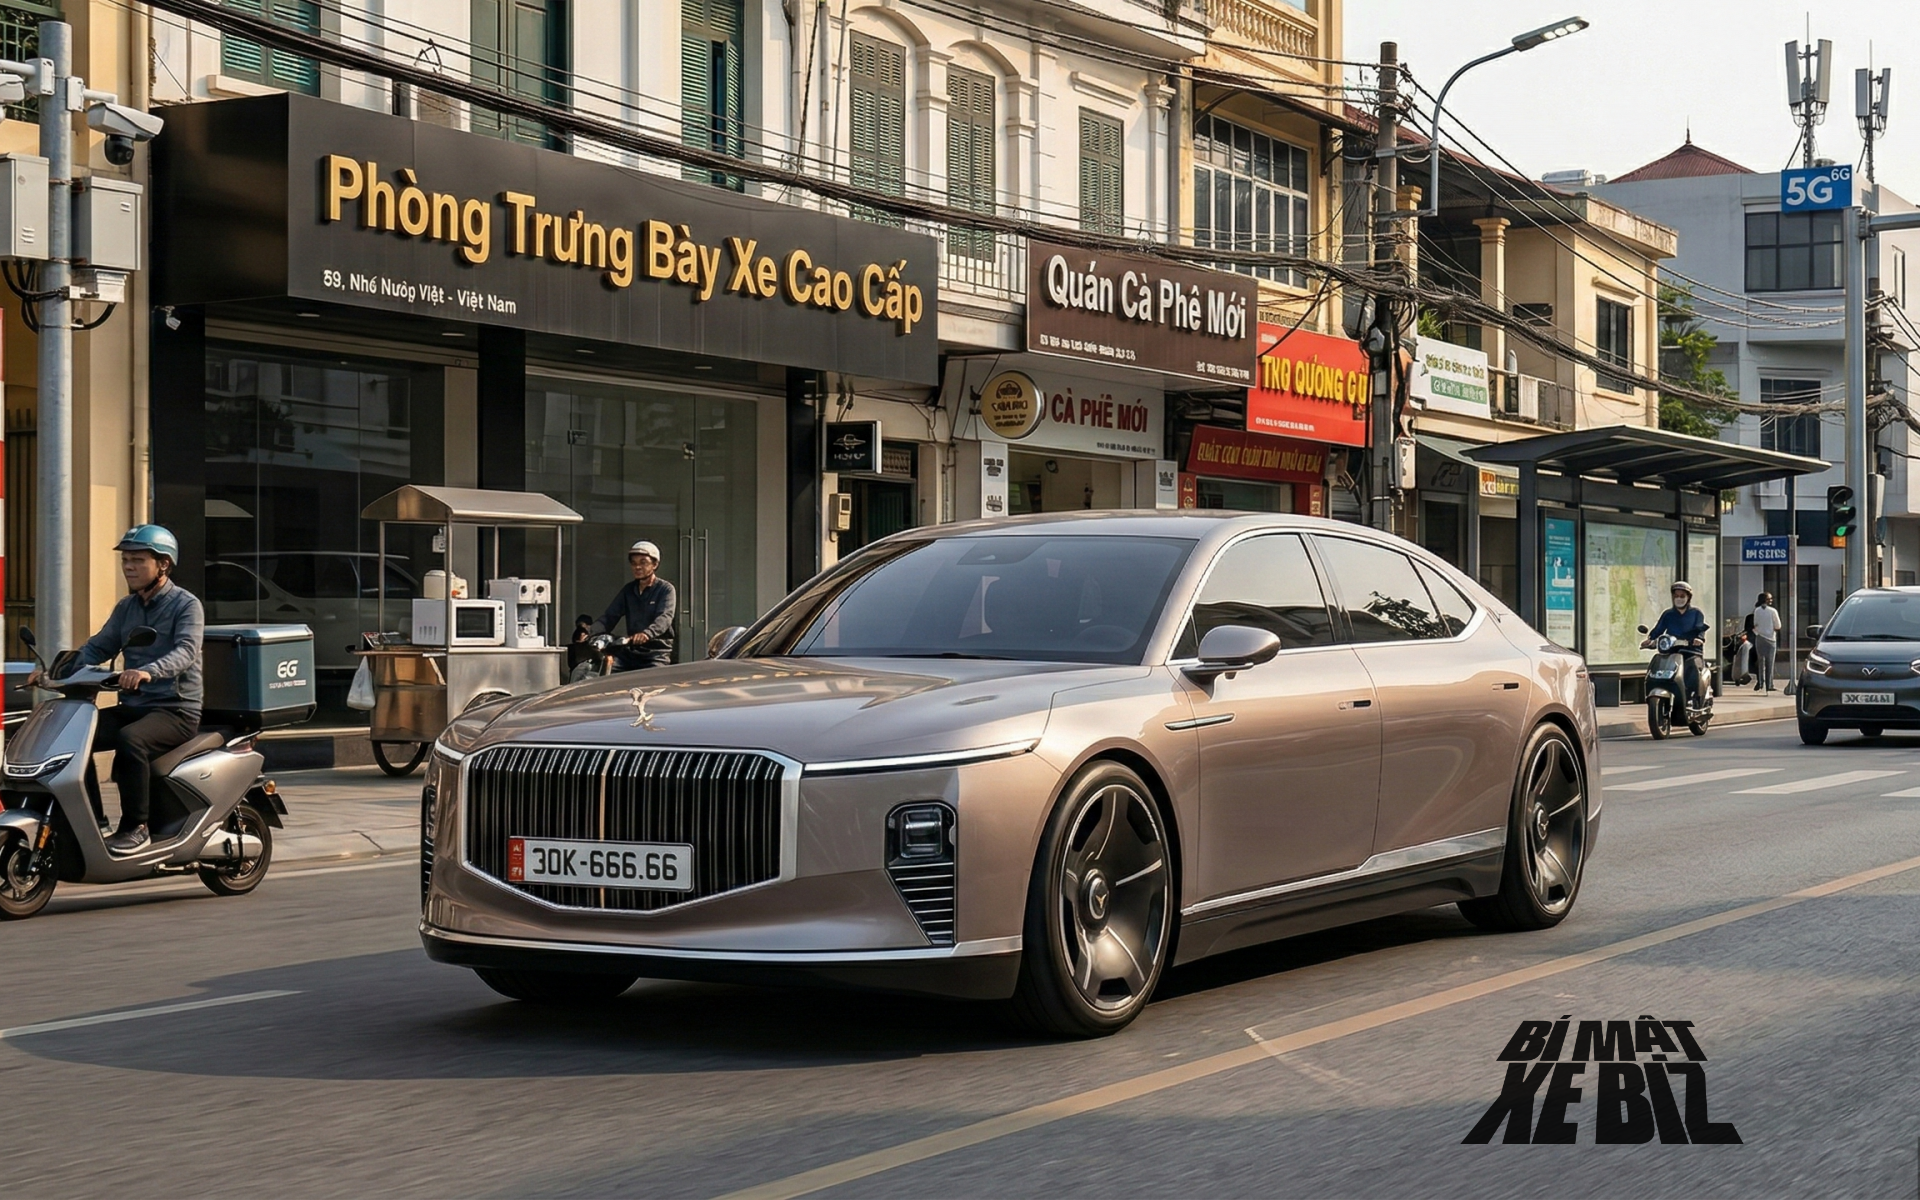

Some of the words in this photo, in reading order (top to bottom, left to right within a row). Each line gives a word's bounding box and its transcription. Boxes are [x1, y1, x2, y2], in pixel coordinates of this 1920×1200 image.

[1786, 176, 1833, 206] 5G
[1831, 168, 1850, 181] 6G
[324, 154, 490, 264] Phòng
[507, 191, 634, 289] Trưng
[644, 219, 721, 301] Bày
[728, 237, 777, 298] Xe
[788, 249, 852, 312] Cao
[862, 261, 924, 334] Cấp
[488, 294, 516, 314] Nam
[1046, 255, 1114, 315] Quán
[1121, 271, 1152, 322] Cà
[1158, 279, 1201, 331] Phê
[1207, 290, 1247, 339] Mới
[1051, 388, 1075, 424] CÀ
[532, 847, 678, 881] 30K-666.66
